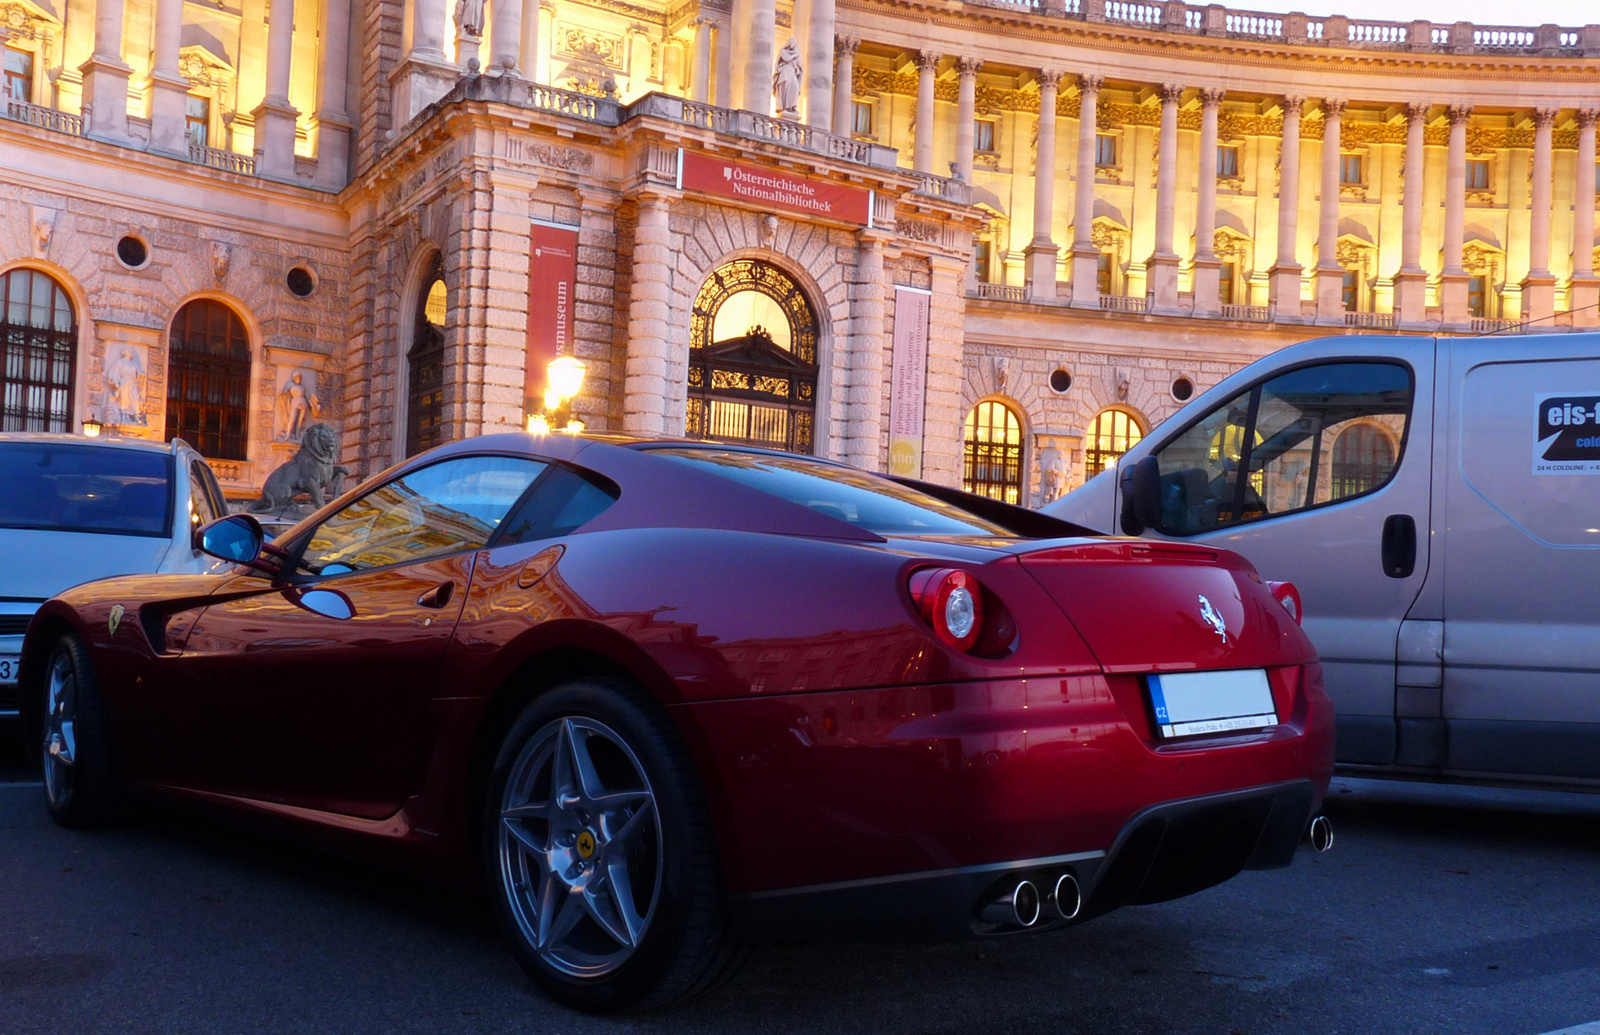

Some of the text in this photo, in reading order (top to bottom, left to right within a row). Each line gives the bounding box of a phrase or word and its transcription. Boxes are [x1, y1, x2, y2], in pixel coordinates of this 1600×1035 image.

[733, 167, 815, 196] Österreichische
[733, 182, 832, 212] Nationalbibliothek
[914, 300, 924, 371] Musikinstrumente
[896, 403, 904, 434] Ephesos
[912, 393, 920, 436] Sammlung
[892, 450, 915, 464] khm
[1156, 707, 1167, 718] CZ
